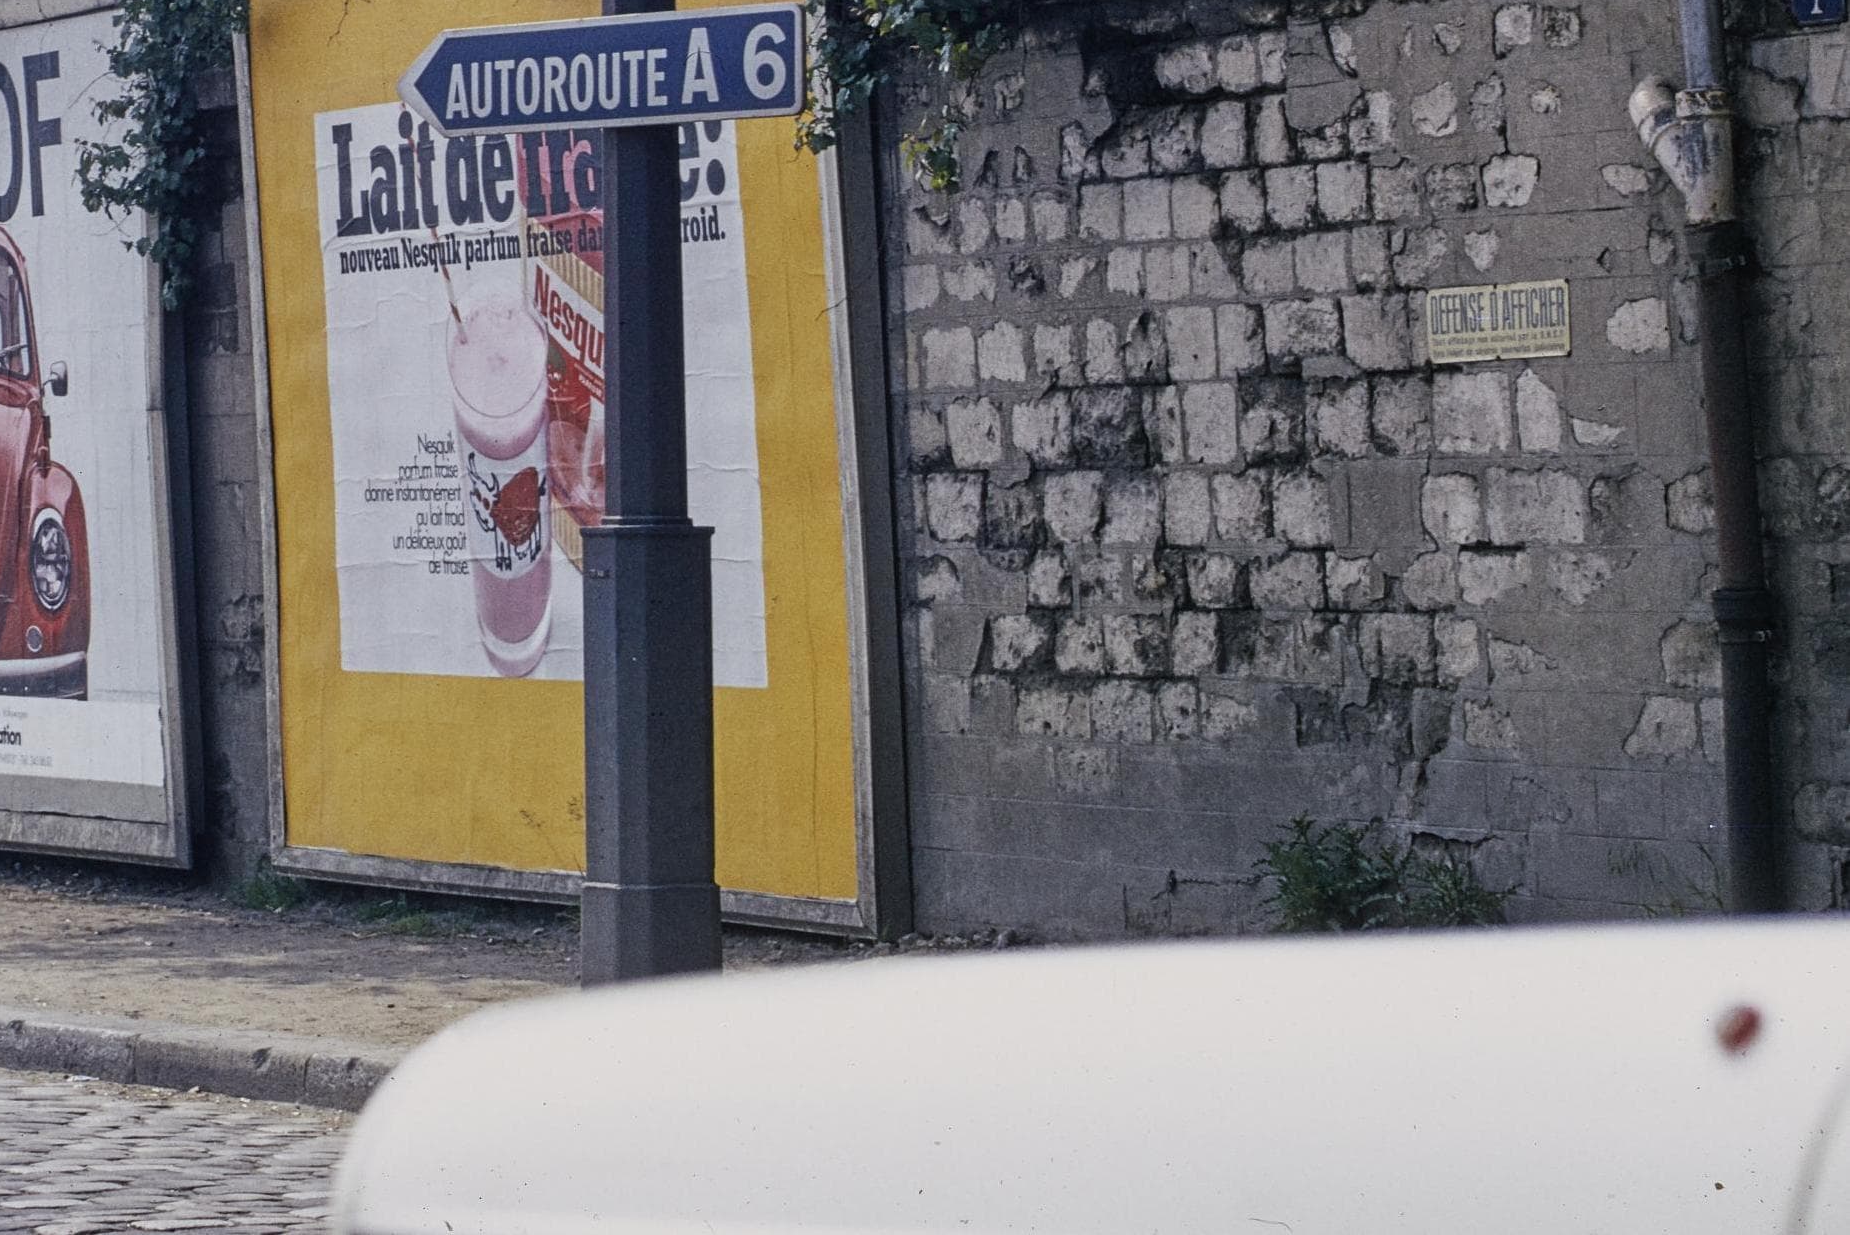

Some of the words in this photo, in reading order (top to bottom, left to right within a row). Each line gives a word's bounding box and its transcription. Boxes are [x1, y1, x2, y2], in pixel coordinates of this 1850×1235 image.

[446, 47, 669, 120] AUTOROUTE
[681, 26, 721, 105] A
[742, 22, 788, 101] 6
[332, 110, 440, 237] Lait
[445, 134, 515, 226] de
[340, 244, 400, 274] nouveau
[401, 233, 462, 272] Nesquik
[465, 230, 521, 270] parfum
[527, 223, 573, 258] fraise
[681, 204, 726, 243] roid.
[534, 264, 604, 369] Nesqu
[417, 430, 456, 461] Nesquik
[398, 455, 433, 485] parfum
[434, 454, 459, 479] fraise
[364, 478, 394, 502] donne
[394, 480, 462, 502] instantanément
[416, 512, 429, 526] au
[429, 502, 443, 526] lait
[444, 501, 466, 527] froid
[393, 534, 405, 550] un
[405, 524, 445, 550] délicieux
[445, 531, 467, 557] goût
[429, 550, 441, 575] de
